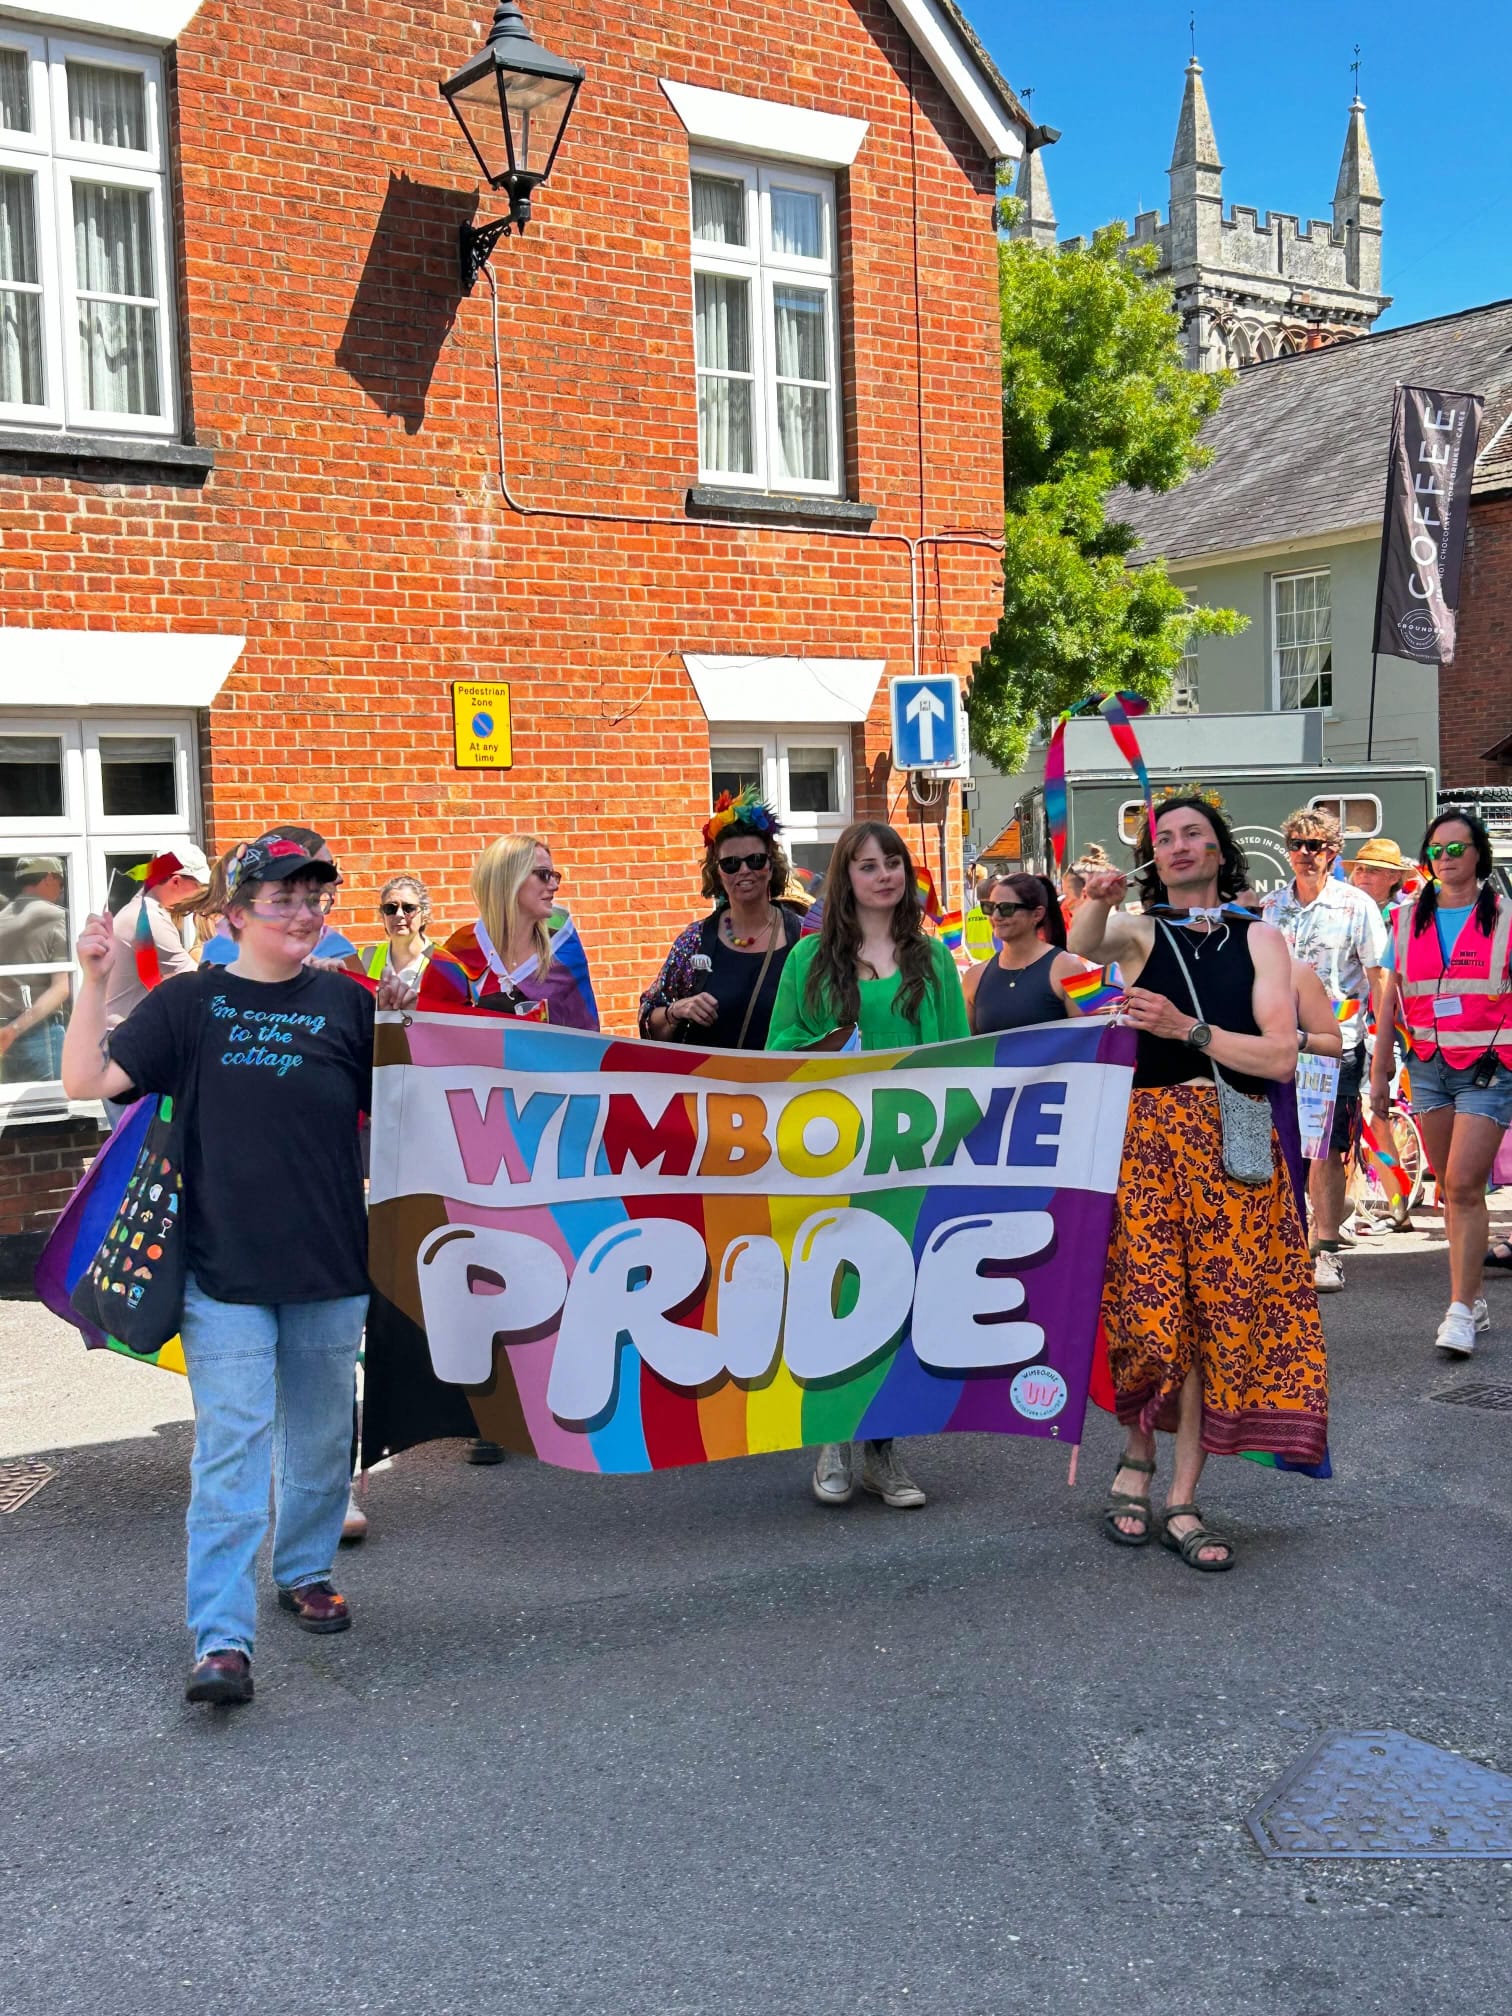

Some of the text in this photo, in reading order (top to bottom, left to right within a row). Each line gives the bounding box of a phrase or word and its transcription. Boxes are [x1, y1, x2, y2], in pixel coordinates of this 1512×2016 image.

[1455, 411, 1466, 438] CAKES
[1408, 406, 1456, 600] COFFEE
[458, 686, 506, 696] Pedestrian
[471, 698, 493, 706] Zone
[469, 742, 499, 752] At any
[475, 754, 495, 762] time
[243, 1010, 326, 1034] coming
[229, 1024, 293, 1043] to the
[221, 1046, 304, 1077] cottage
[444, 1082, 1068, 1185] WIMBORNE
[416, 1206, 1056, 1422] PRIDE
[1022, 1369, 1058, 1382] WIMBORNE
